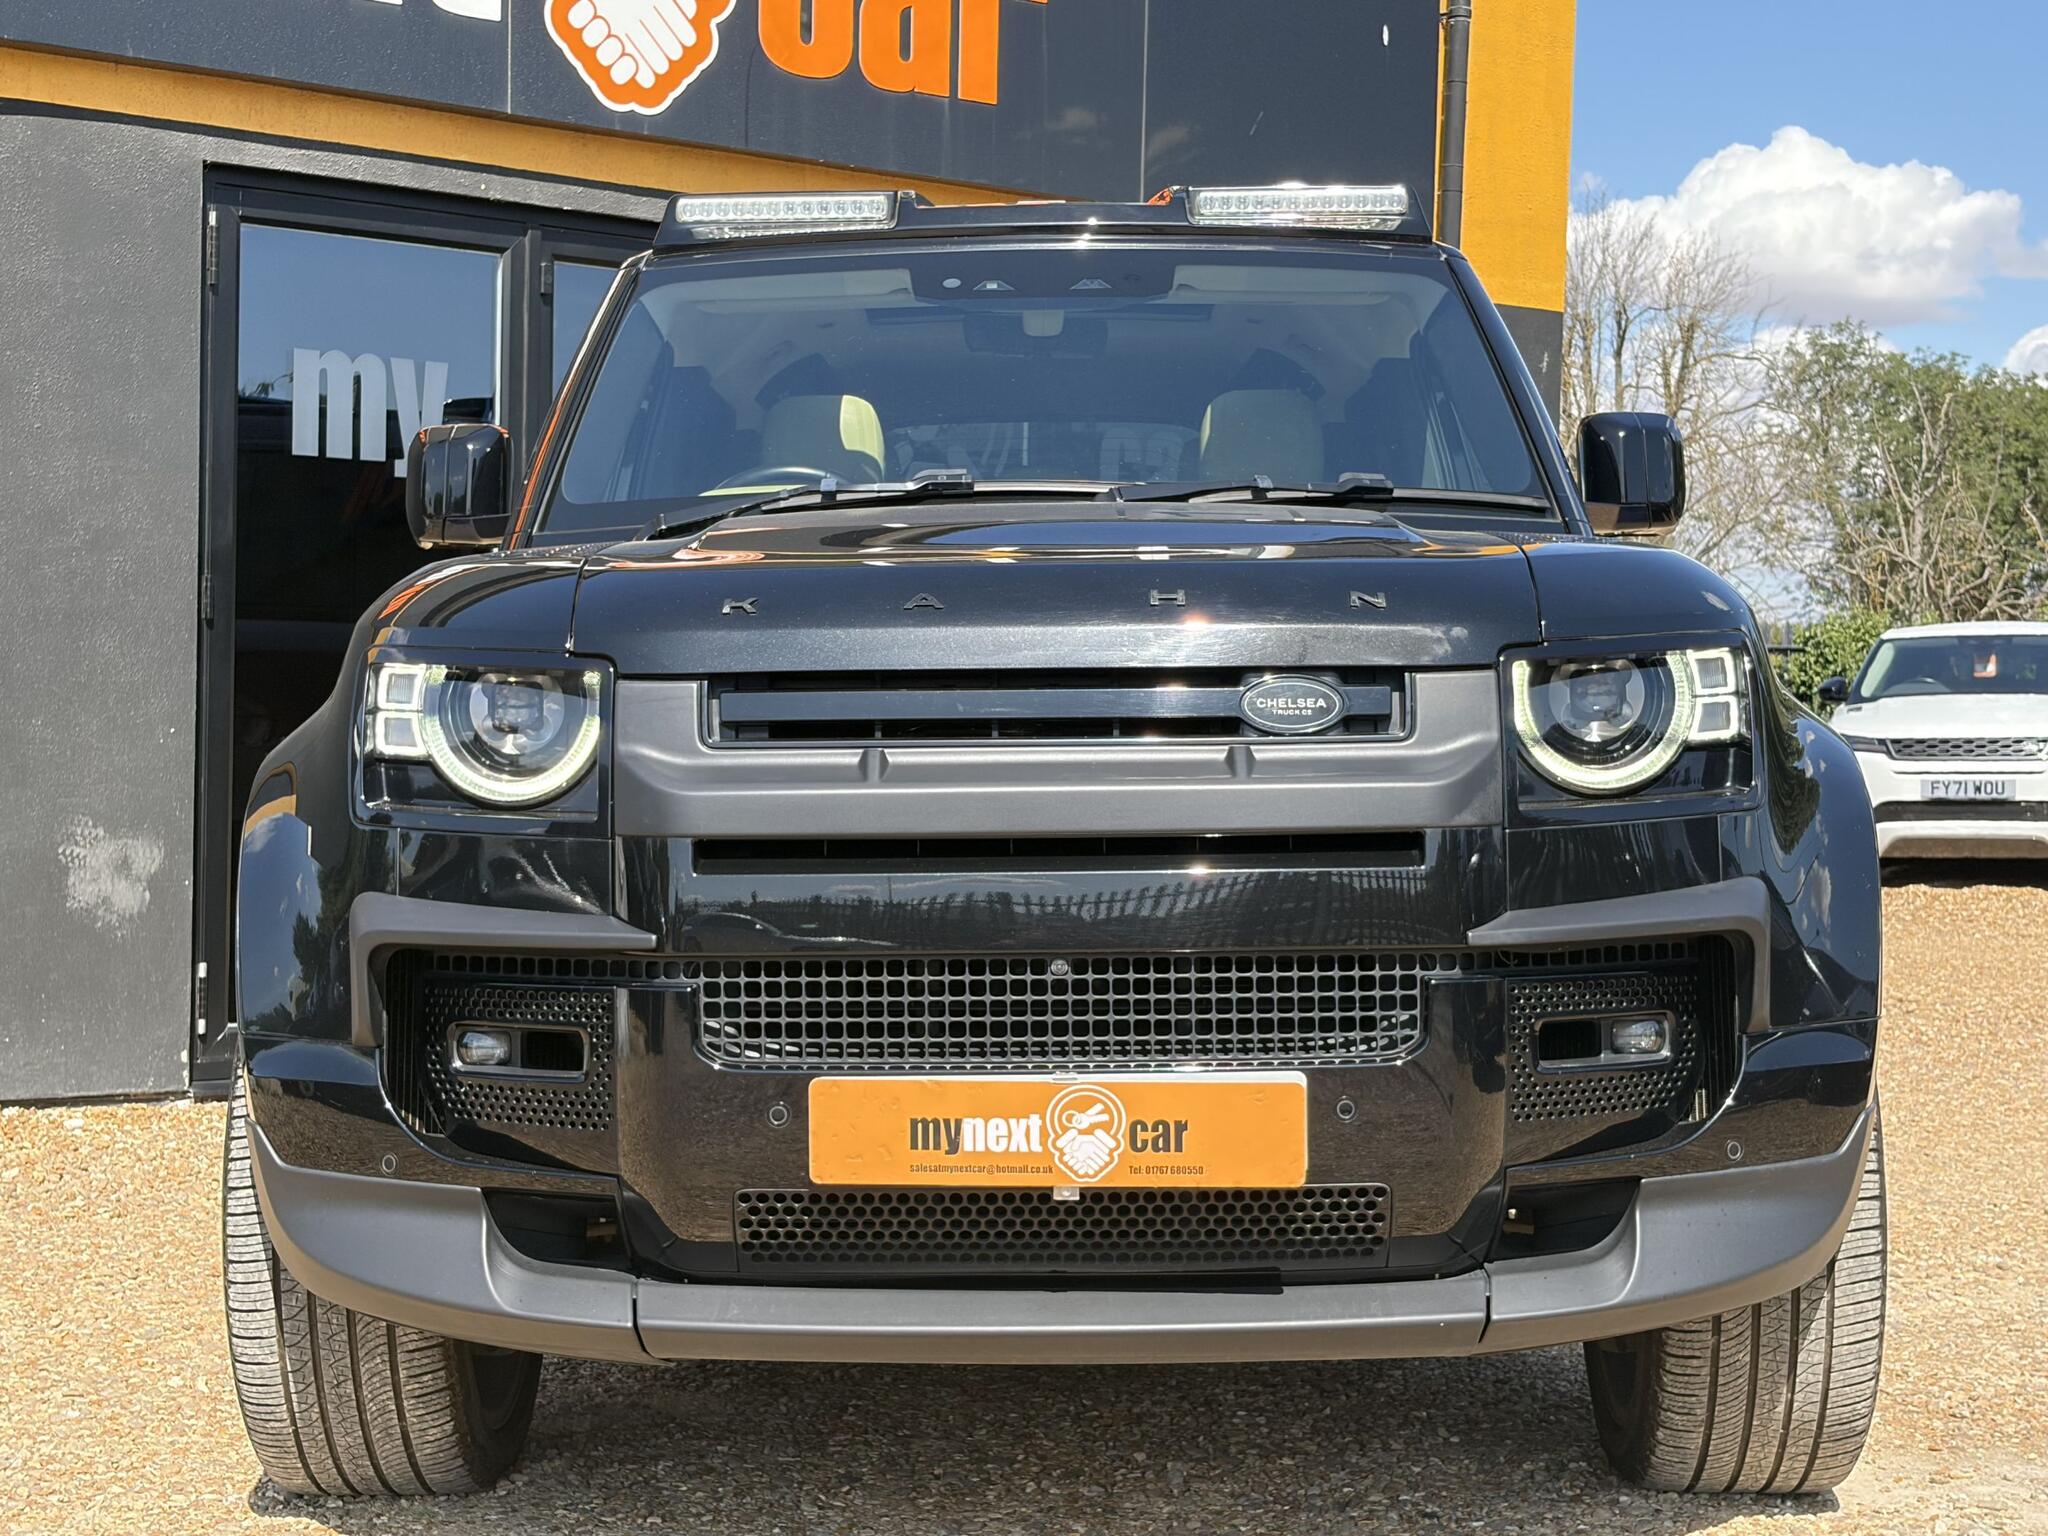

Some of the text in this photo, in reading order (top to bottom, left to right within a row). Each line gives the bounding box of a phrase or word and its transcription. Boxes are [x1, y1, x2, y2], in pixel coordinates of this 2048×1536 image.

[292, 347, 449, 478] my
[1256, 697, 1326, 708] CHELSEA
[1272, 708, 1300, 716] TRUCK
[1930, 780, 2006, 796] FY71 WOU
[1128, 1118, 1189, 1153] car
[1128, 1165, 1145, 1175] Tel:
[1145, 1165, 1169, 1175] 01767
[1170, 1165, 1205, 1175] 680550
